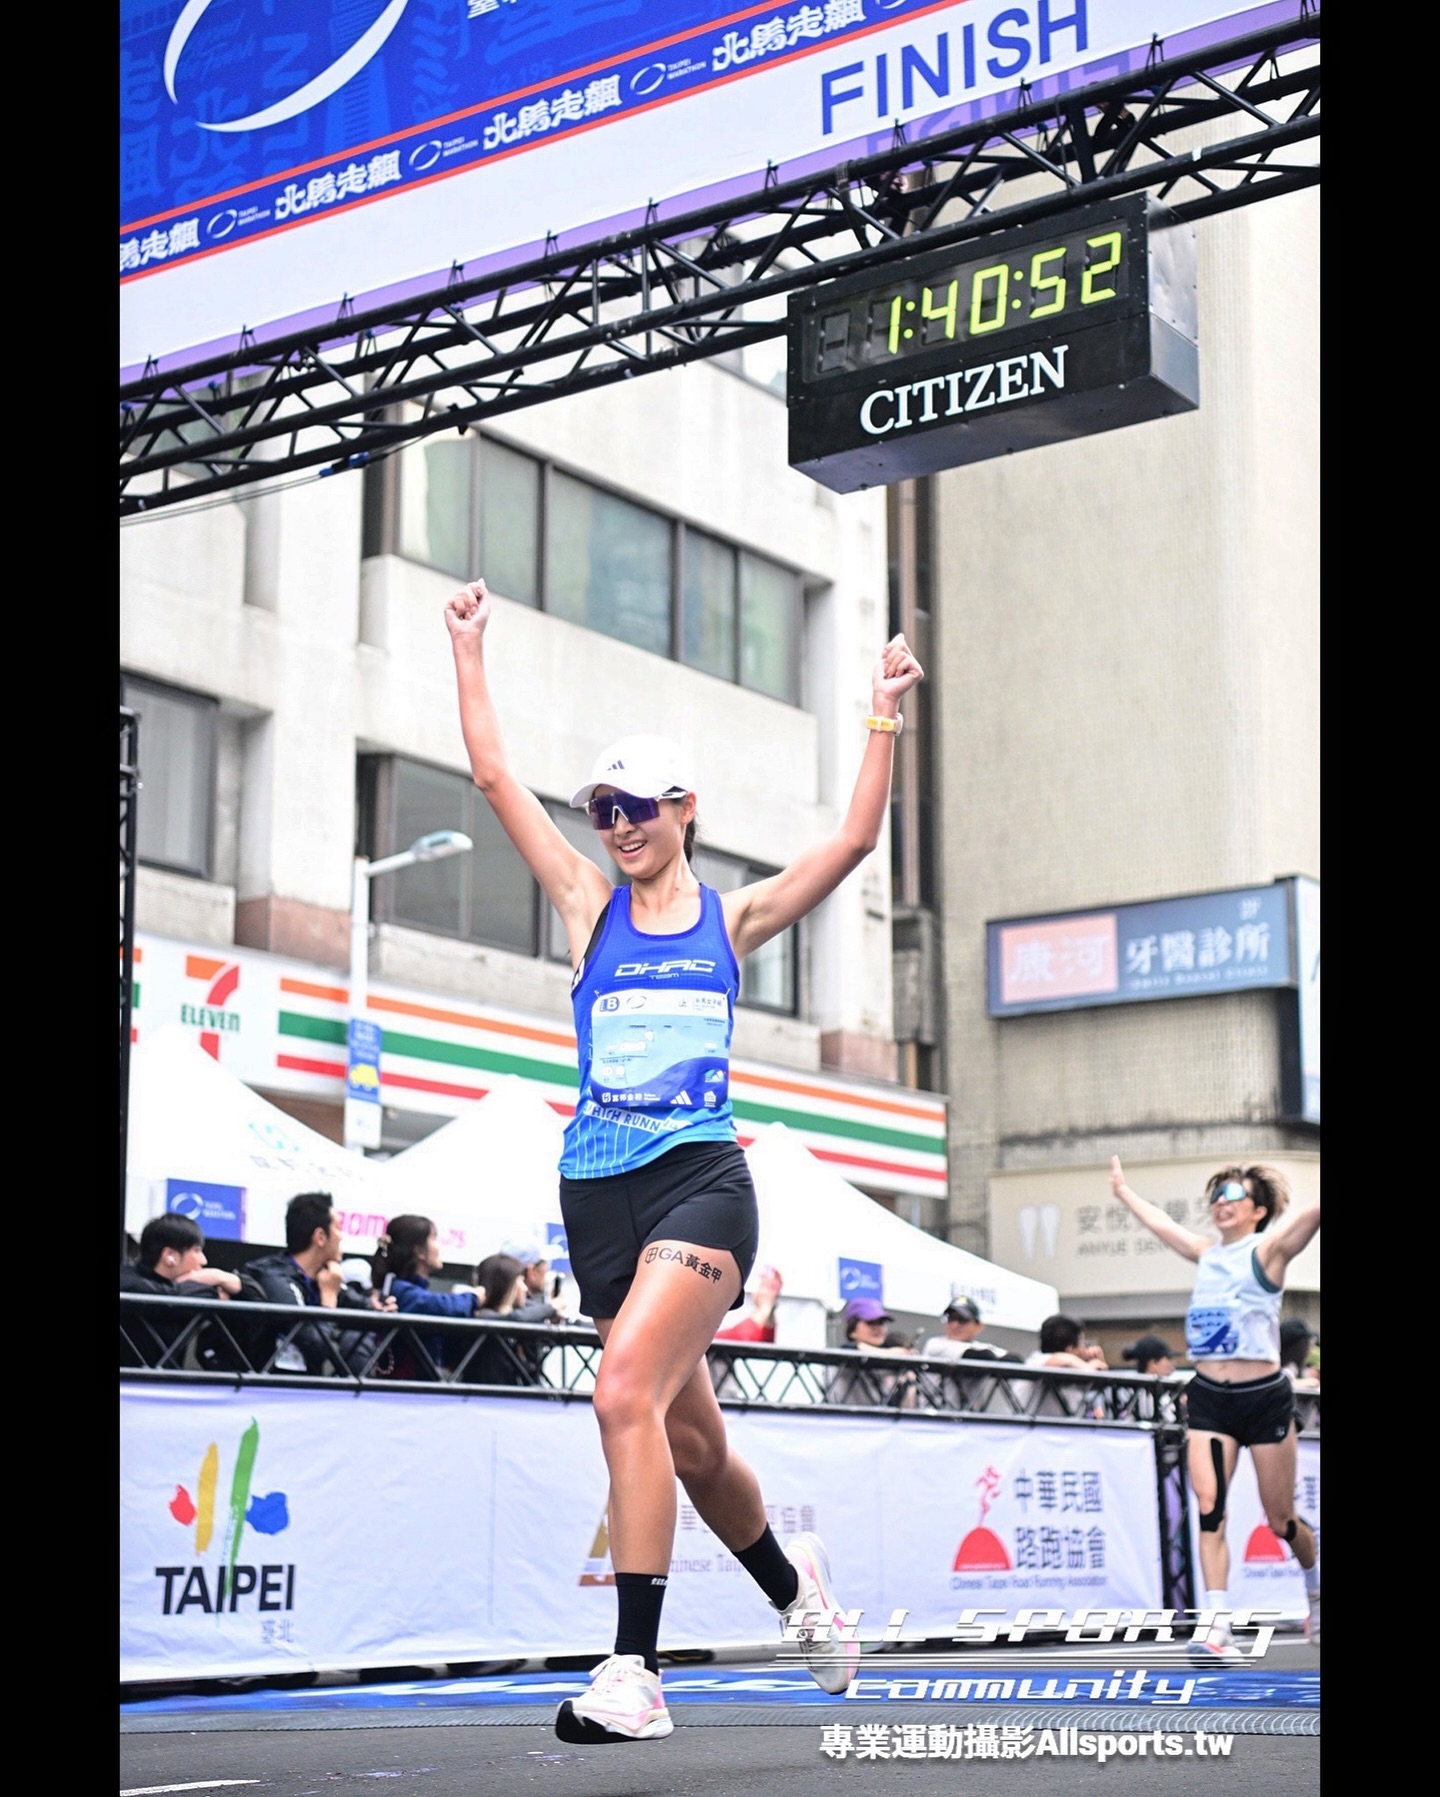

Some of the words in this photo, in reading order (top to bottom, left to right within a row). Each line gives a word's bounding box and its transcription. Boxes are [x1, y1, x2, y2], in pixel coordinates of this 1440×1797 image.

[667, 57, 691, 71] TAIPEI
[667, 61, 706, 79] MARATHON
[821, 0, 1087, 135] FINISH
[888, 231, 1122, 354] 1:40:52
[859, 344, 1069, 435] CITIZEN
[1013, 1468, 1103, 1513] 中華民國
[1015, 1525, 1106, 1569] 路跑協會
[155, 1564, 295, 1615] TAIPEI
